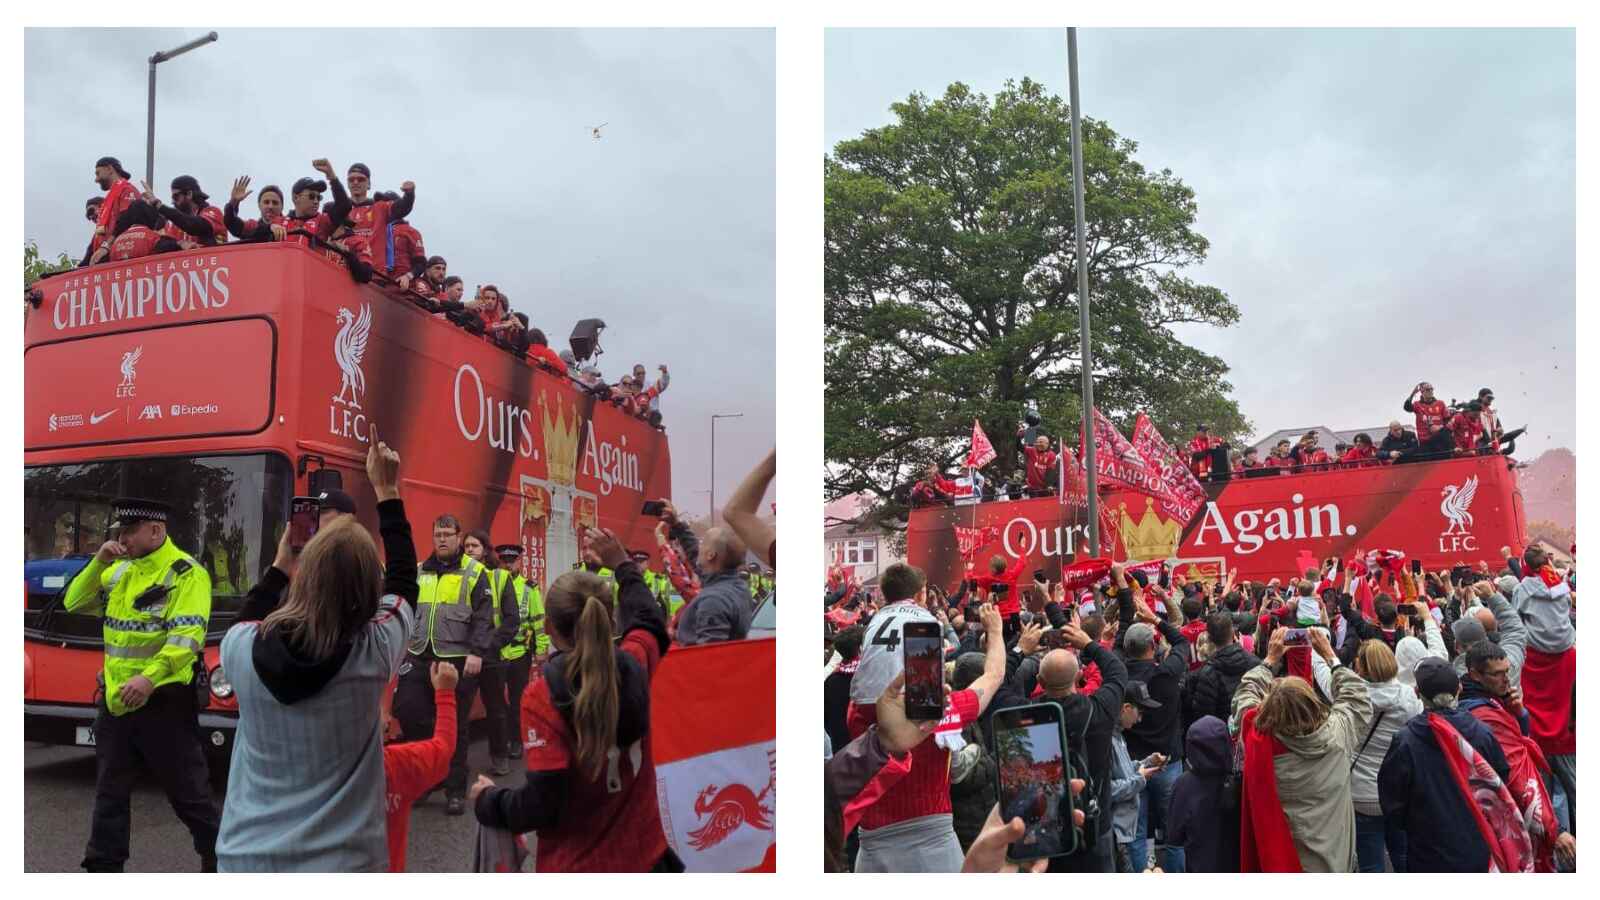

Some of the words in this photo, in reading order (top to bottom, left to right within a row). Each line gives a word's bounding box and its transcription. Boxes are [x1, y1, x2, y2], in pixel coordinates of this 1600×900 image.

[65, 268, 133, 289] PREMIER
[145, 256, 218, 274] LEAGUE
[53, 267, 230, 331] CHAMPIONS
[138, 404, 163, 420] AXA
[455, 364, 539, 461] Ours.
[582, 420, 644, 496] Again.
[1194, 493, 1357, 554] Again.
[871, 615, 901, 652] 4
